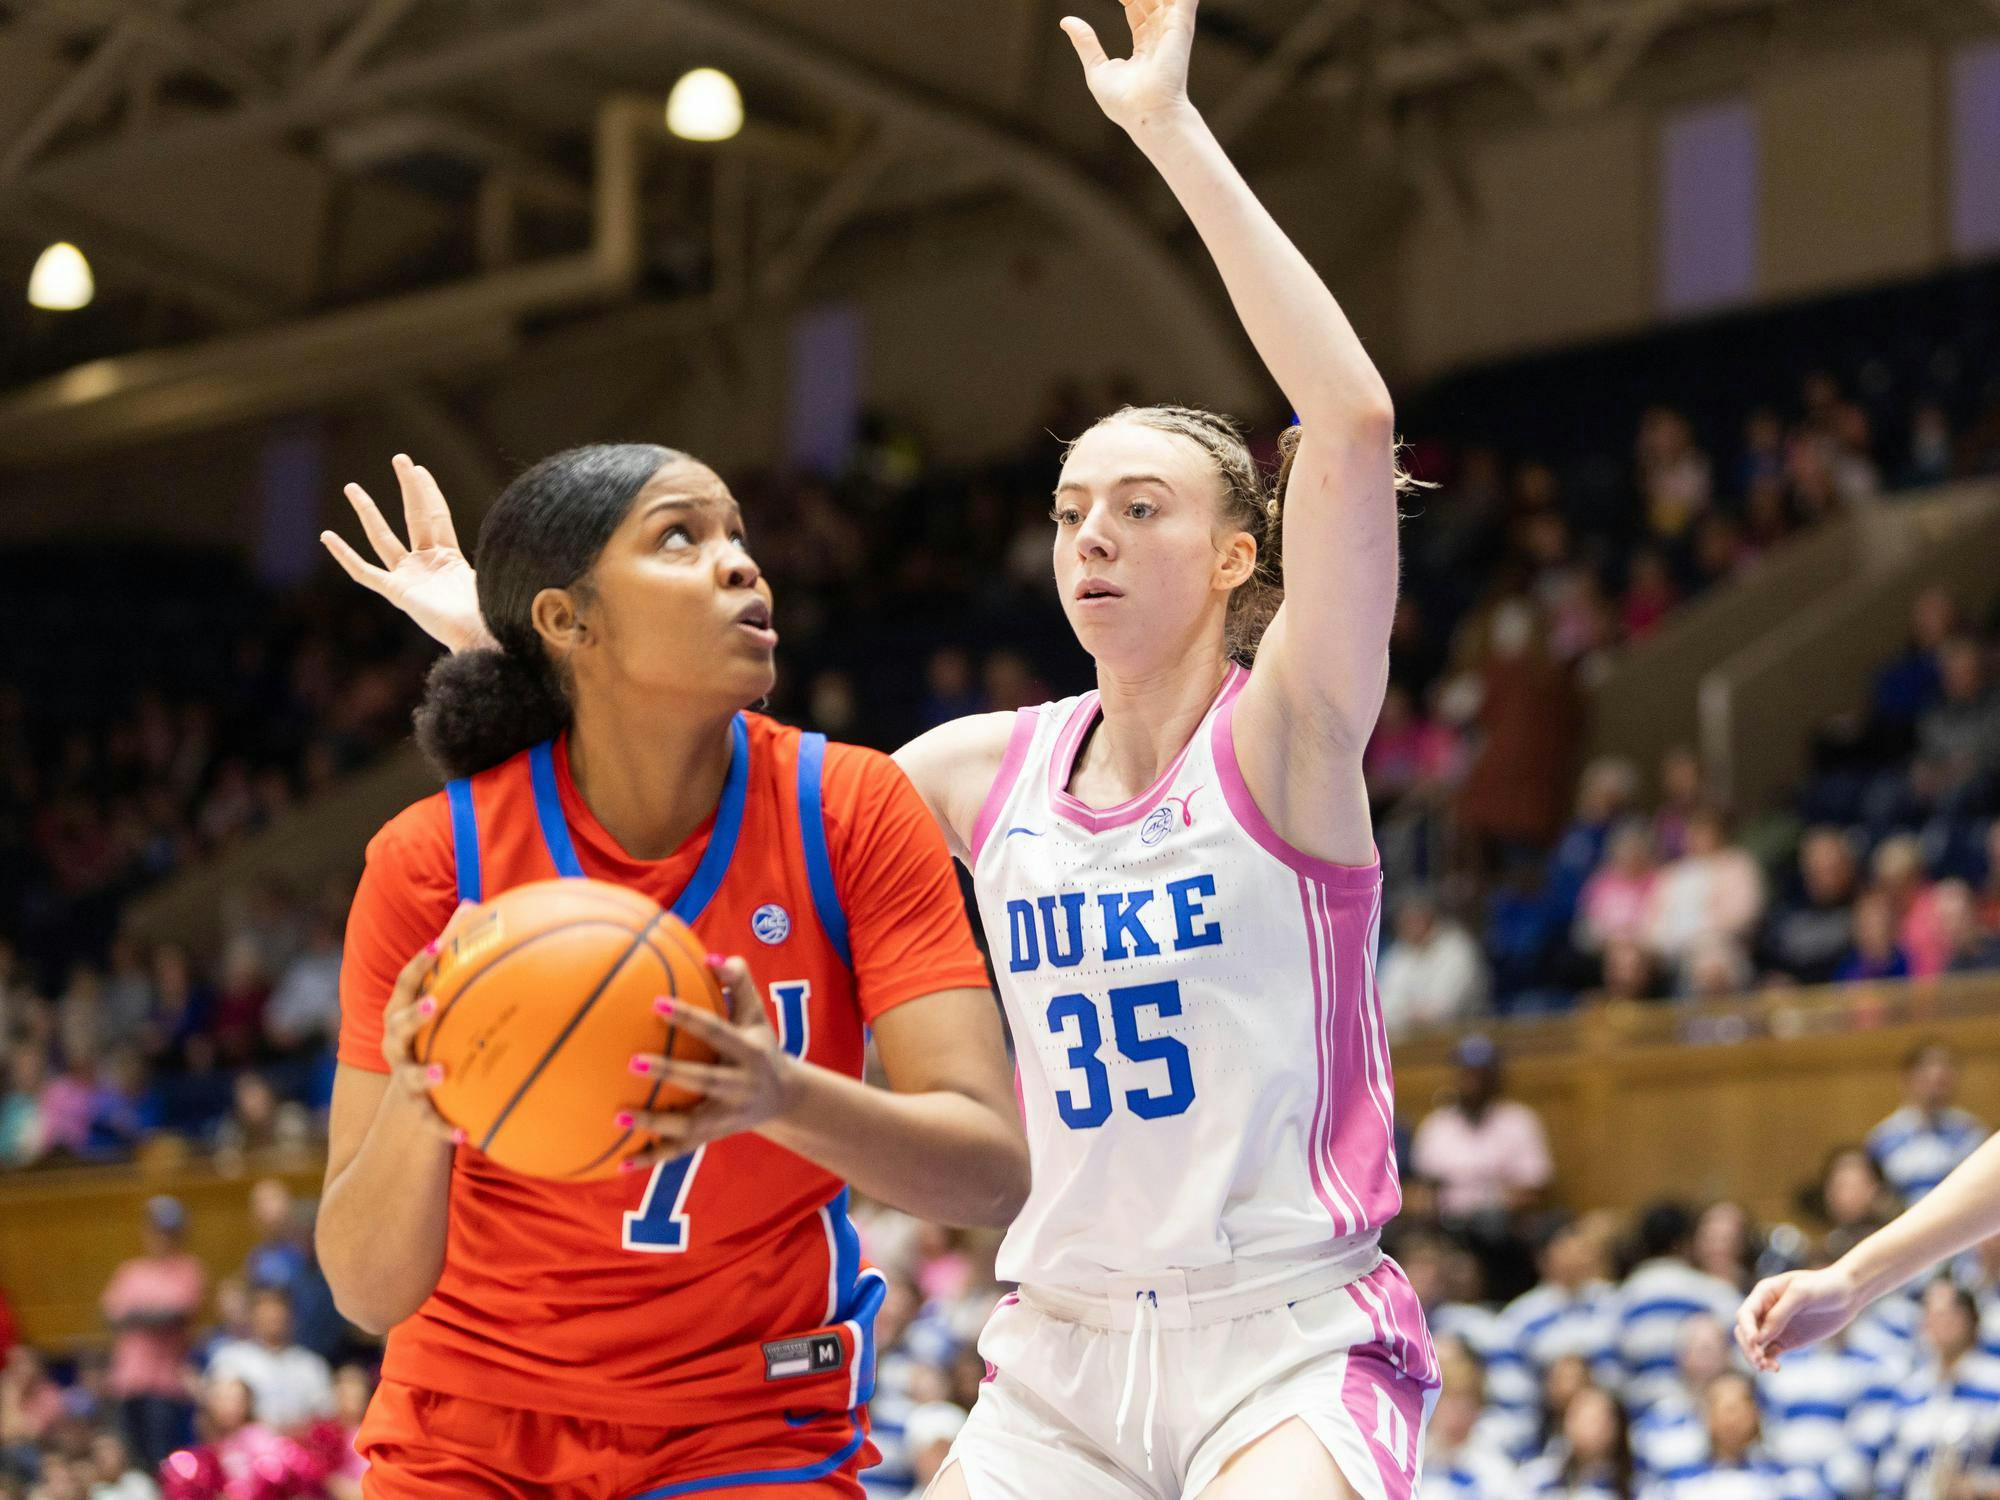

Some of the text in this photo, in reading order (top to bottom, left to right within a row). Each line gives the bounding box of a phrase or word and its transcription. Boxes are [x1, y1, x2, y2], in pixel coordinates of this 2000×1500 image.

[1006, 873, 1223, 974] DUKE
[1045, 979, 1197, 1131] 35
[818, 1342, 835, 1363] M
[1370, 1381, 1409, 1473] D
